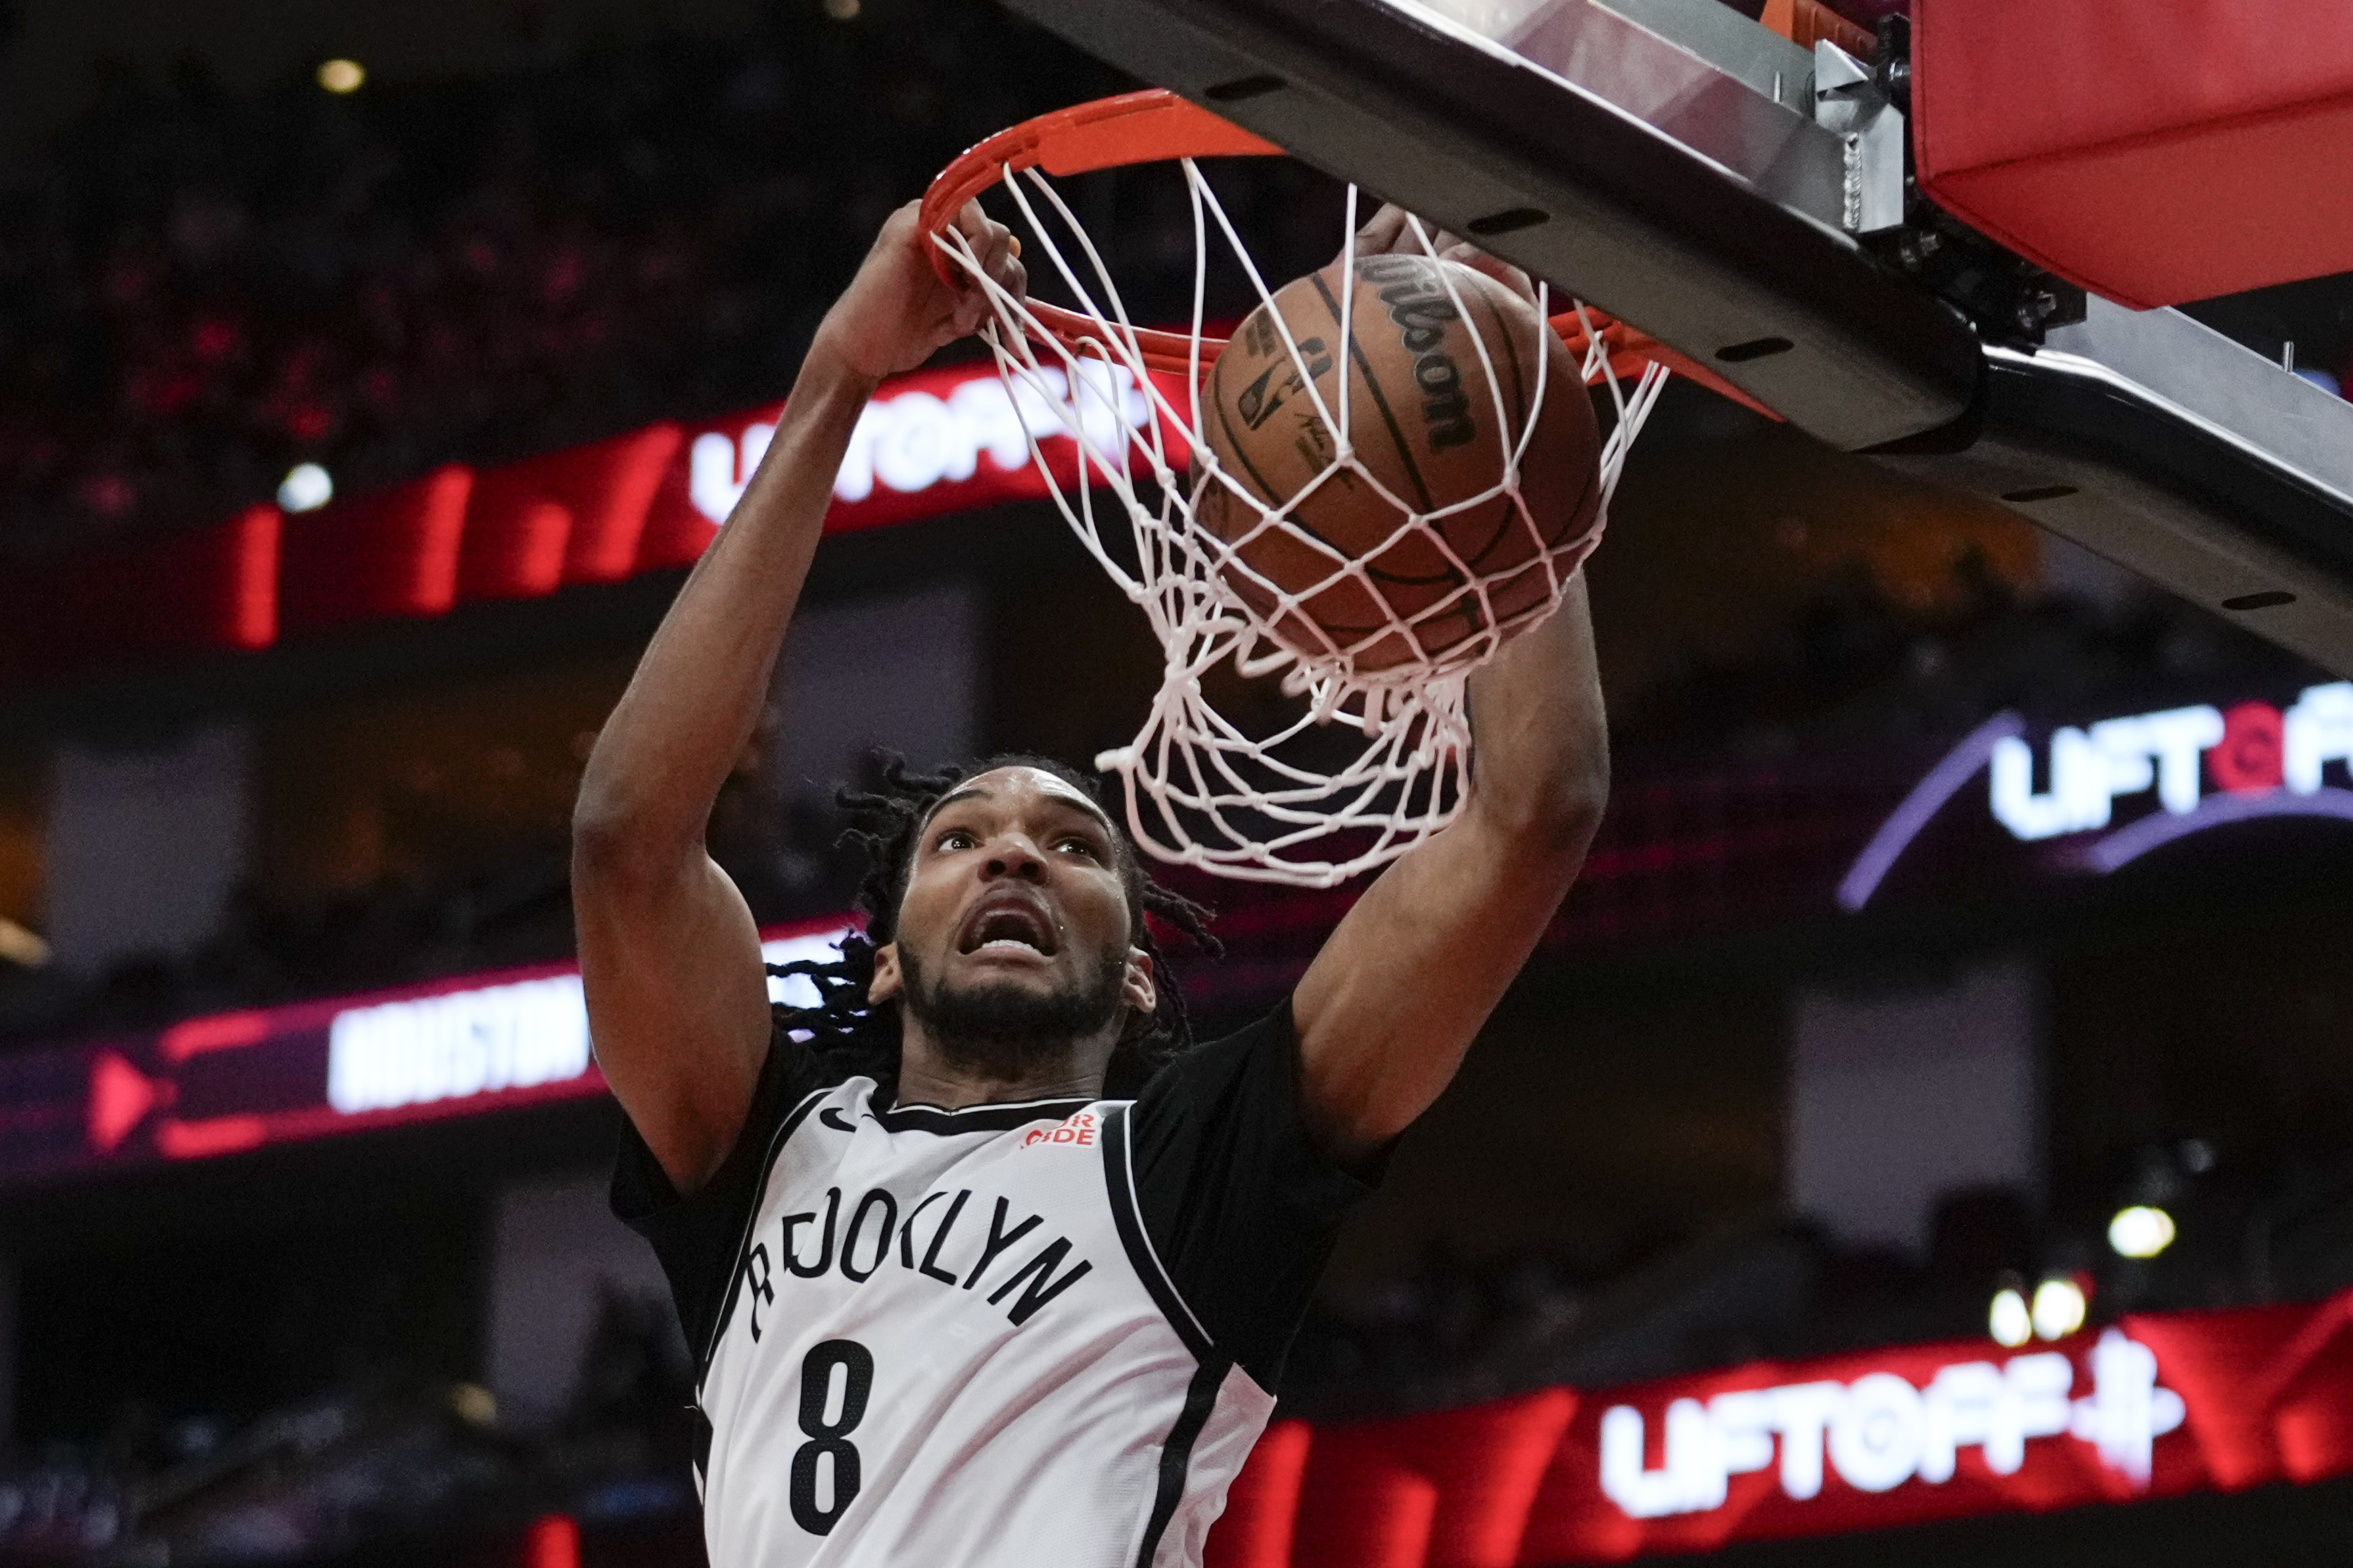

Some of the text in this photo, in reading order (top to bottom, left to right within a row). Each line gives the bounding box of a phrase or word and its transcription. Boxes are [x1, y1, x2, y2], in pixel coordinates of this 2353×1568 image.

[1353, 256, 1477, 453] Wilson
[1990, 680, 2353, 841] LIFTOF
[789, 1339, 875, 1536] 8
[1599, 1352, 2074, 1519] LIFTOFF
